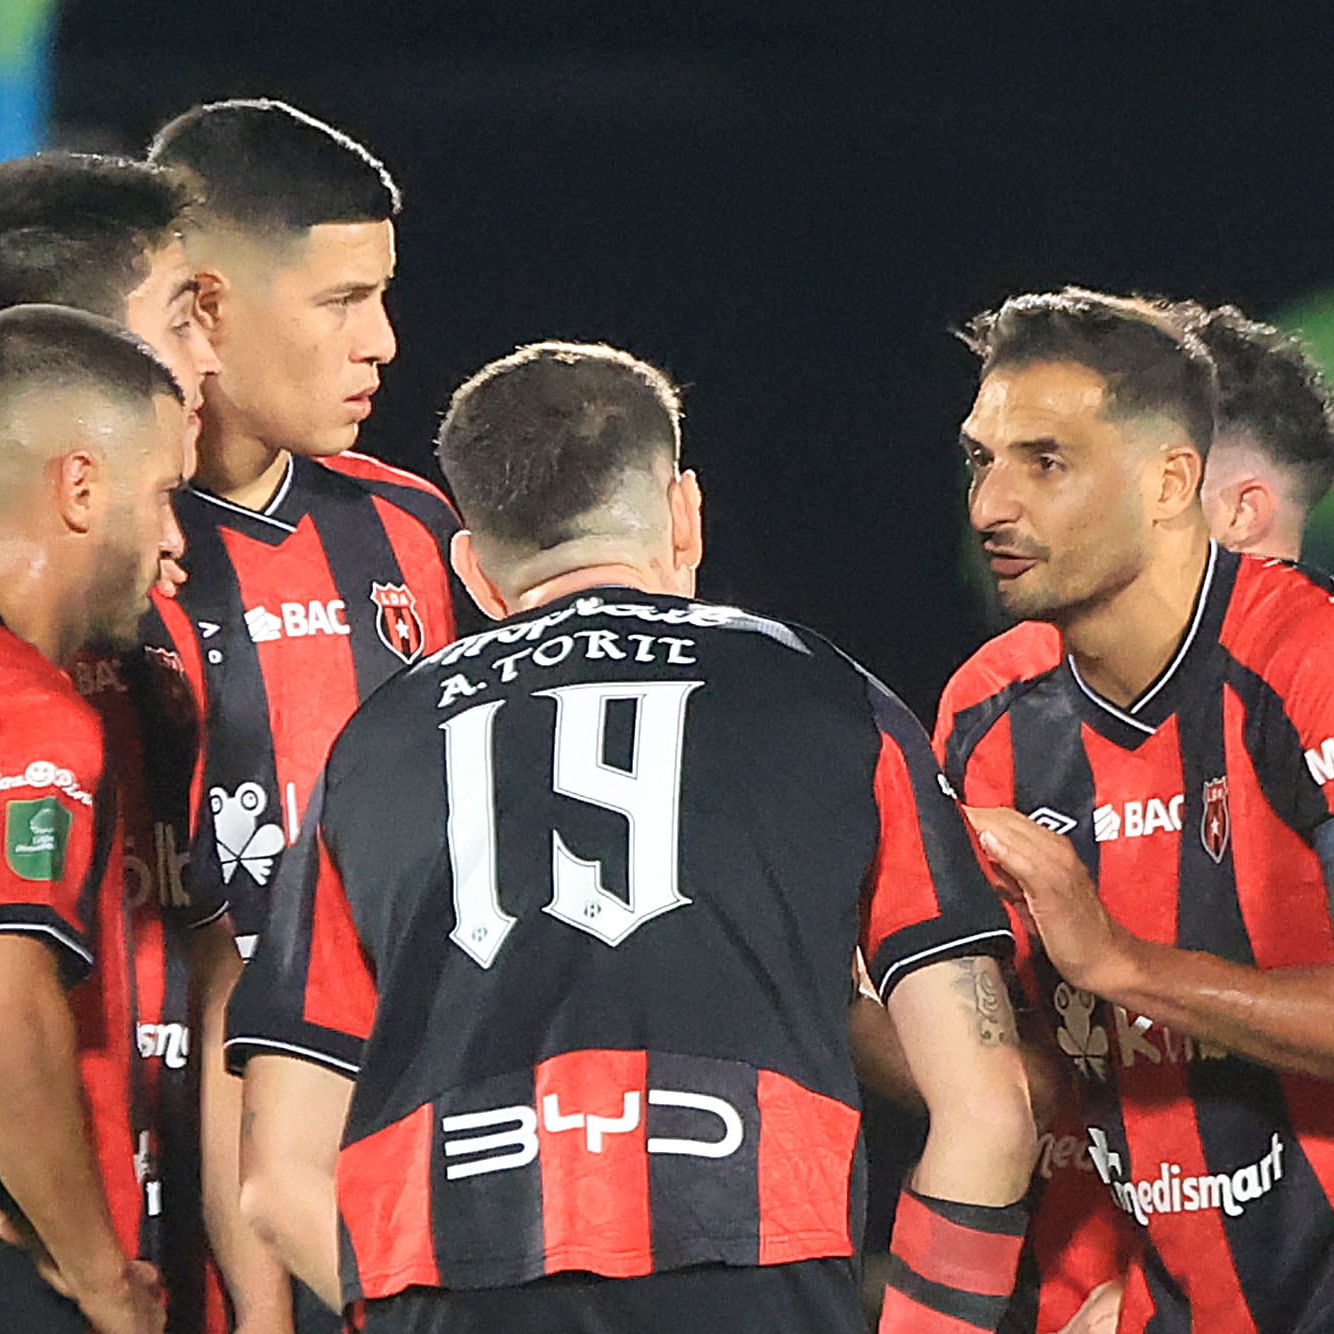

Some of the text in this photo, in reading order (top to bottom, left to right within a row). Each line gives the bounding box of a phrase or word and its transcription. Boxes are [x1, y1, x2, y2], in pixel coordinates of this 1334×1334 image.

[280, 600, 351, 637] BAC
[379, 592, 409, 606] LDA
[437, 681, 706, 969] 19
[442, 1089, 744, 1180] BYD
[1112, 1132, 1284, 1226] medismart
